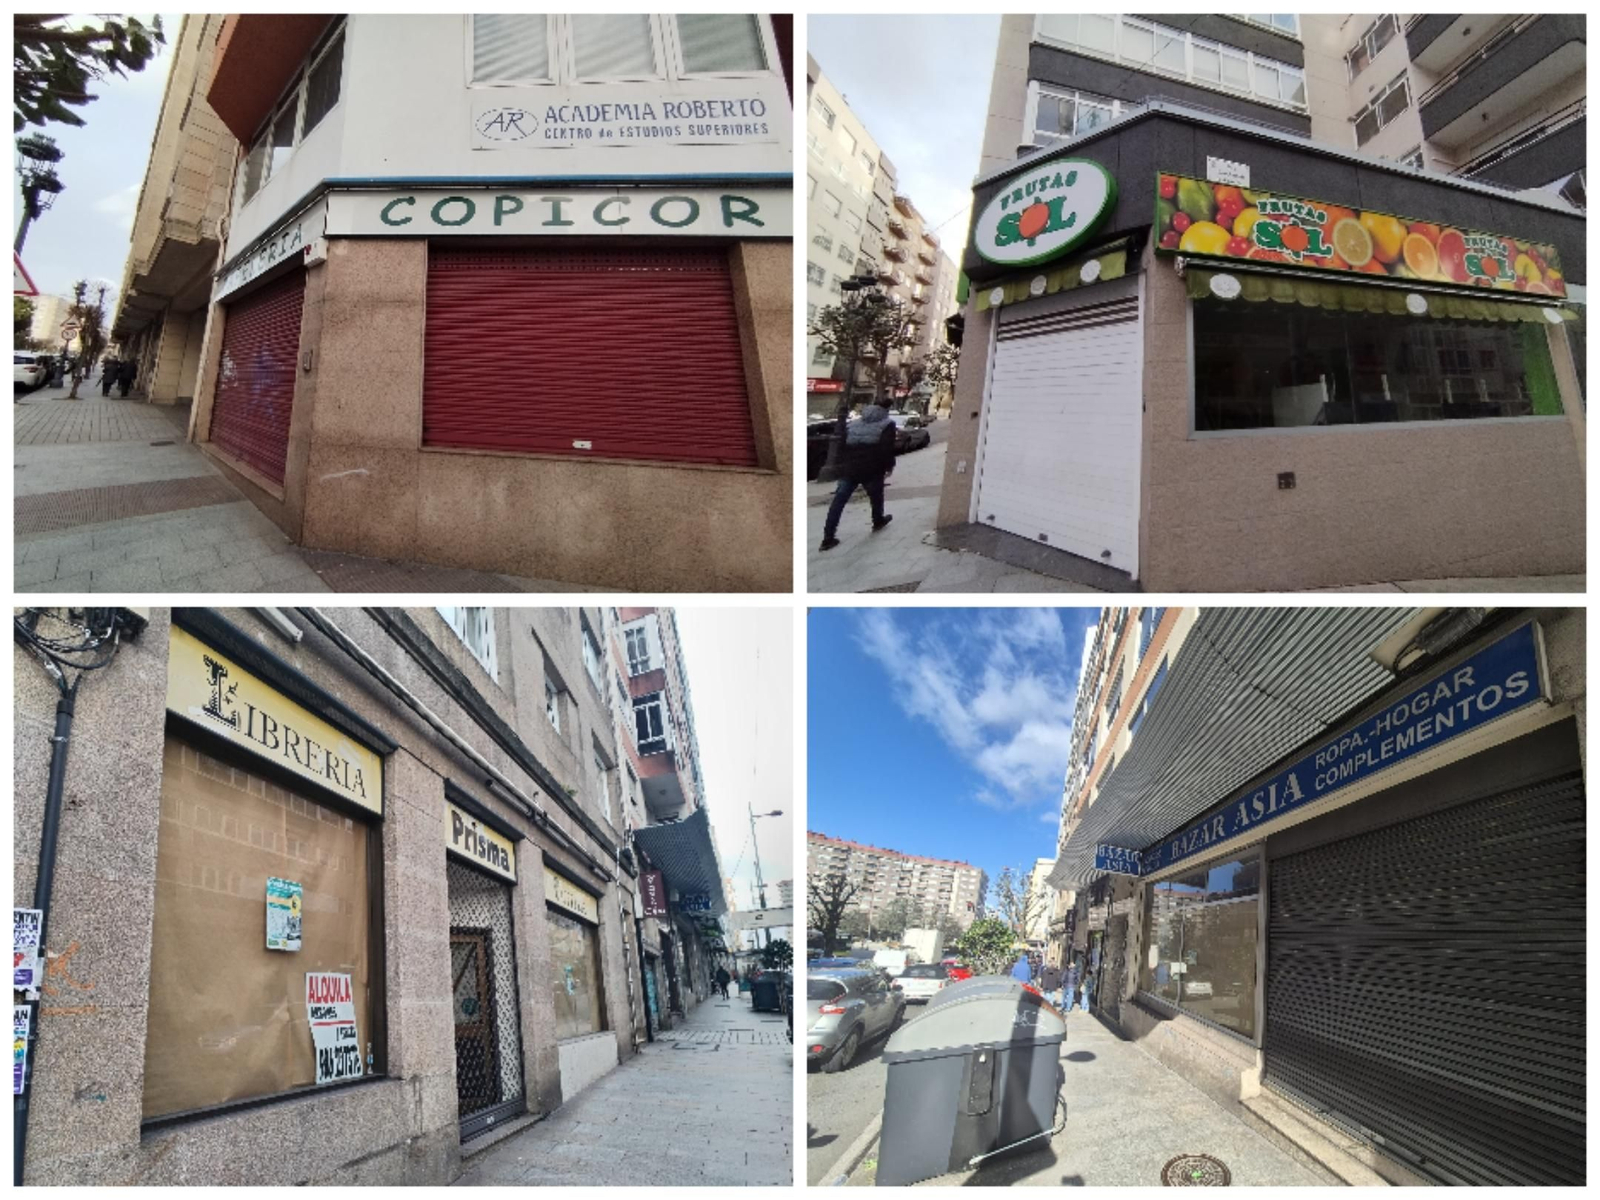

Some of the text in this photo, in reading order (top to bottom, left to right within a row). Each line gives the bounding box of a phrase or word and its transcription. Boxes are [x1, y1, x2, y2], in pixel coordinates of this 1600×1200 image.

[544, 98, 767, 124] ACADEMIA ROBERTO
[544, 127, 593, 140] CENTRO
[619, 125, 682, 138] ESTUDIOS
[688, 122, 769, 137] SUPERIORES
[999, 169, 1078, 211] FRUTAS
[380, 194, 765, 228] COPICOR
[995, 196, 1077, 247] SOL
[1257, 199, 1327, 224] FRUTAS
[1253, 217, 1333, 259] SOL
[1464, 235, 1508, 256] FRUTAS
[1464, 253, 1516, 282] SOL
[201, 653, 367, 799] LIBRERIA
[1314, 671, 1530, 791] COMPLEMENTOS
[1170, 814, 1226, 860] BAZAR
[1232, 771, 1305, 831] ASIA
[451, 809, 511, 873] Prisma
[1098, 843, 1141, 866] BAZAR
[1102, 859, 1131, 873] ASIA
[308, 975, 351, 1004] ALQUILA
